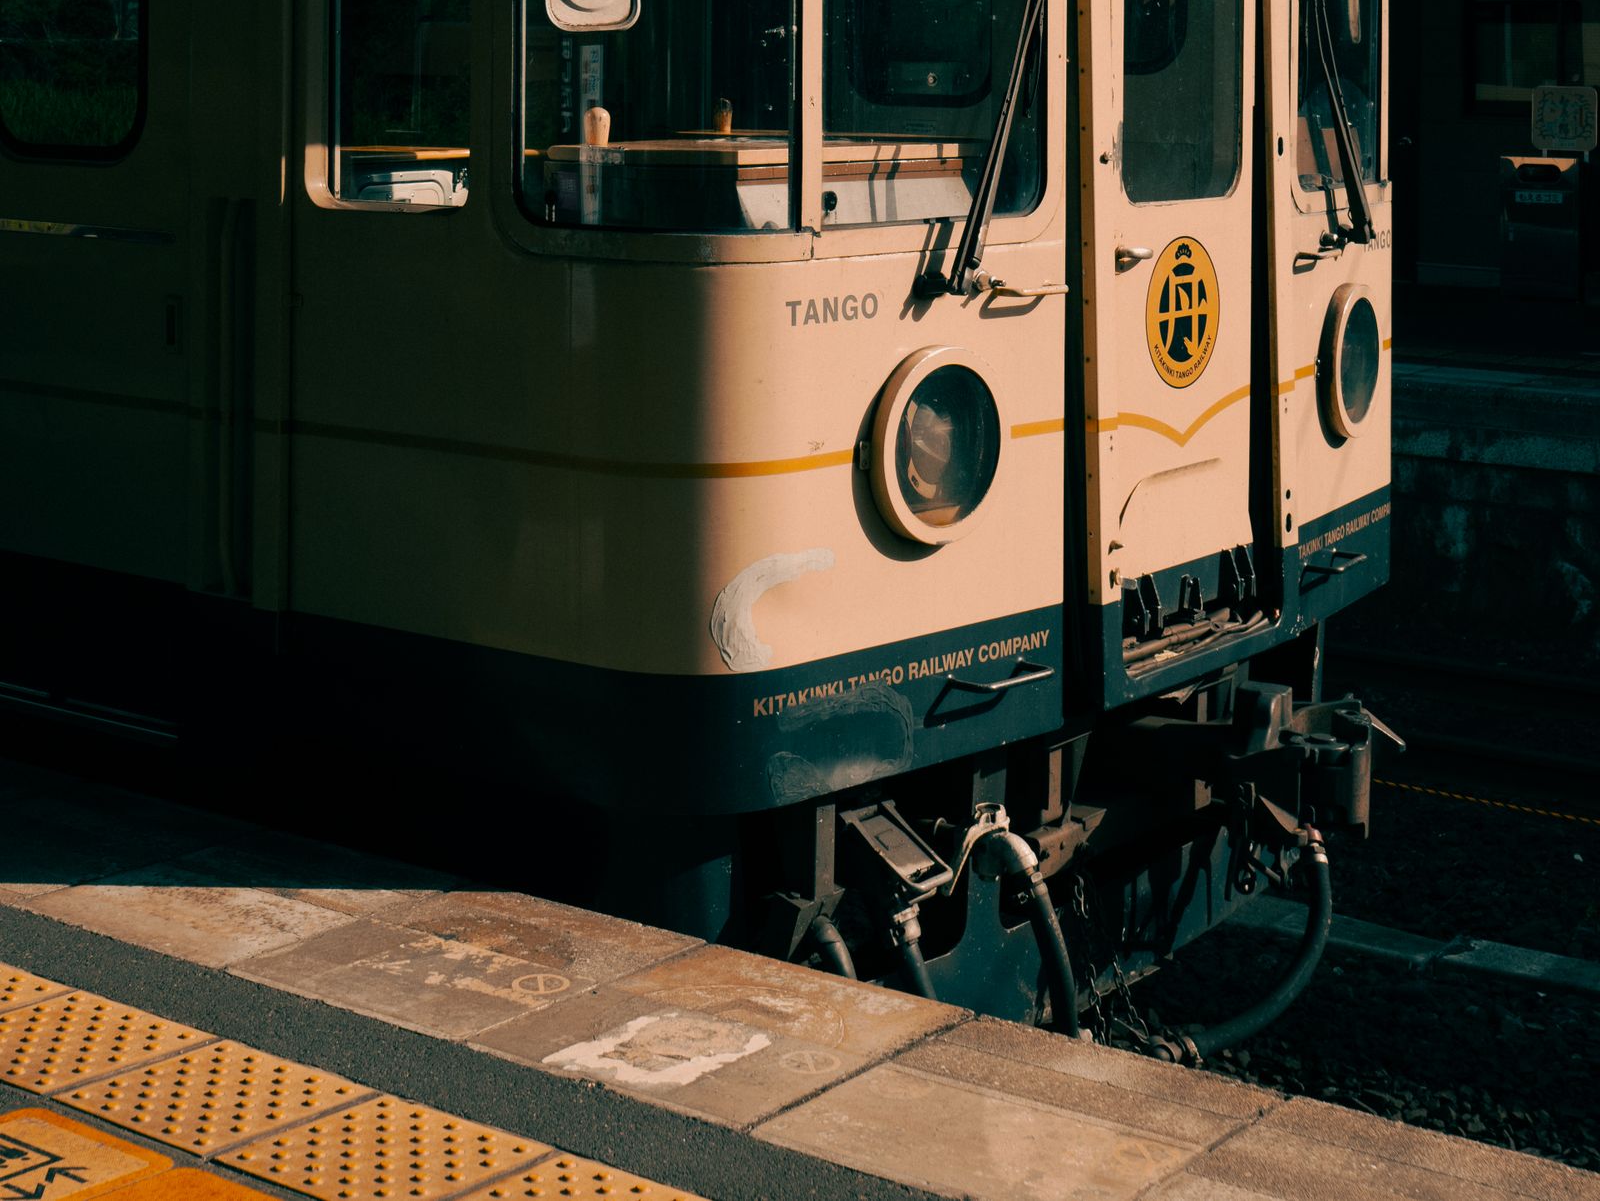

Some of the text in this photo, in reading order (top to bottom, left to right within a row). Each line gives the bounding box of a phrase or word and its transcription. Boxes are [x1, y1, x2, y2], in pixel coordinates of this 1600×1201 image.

[785, 292, 878, 327] TANGO
[753, 679, 844, 718] KITAKINKI
[908, 648, 975, 681] RAILWAY
[978, 629, 1050, 664] COMPANY
